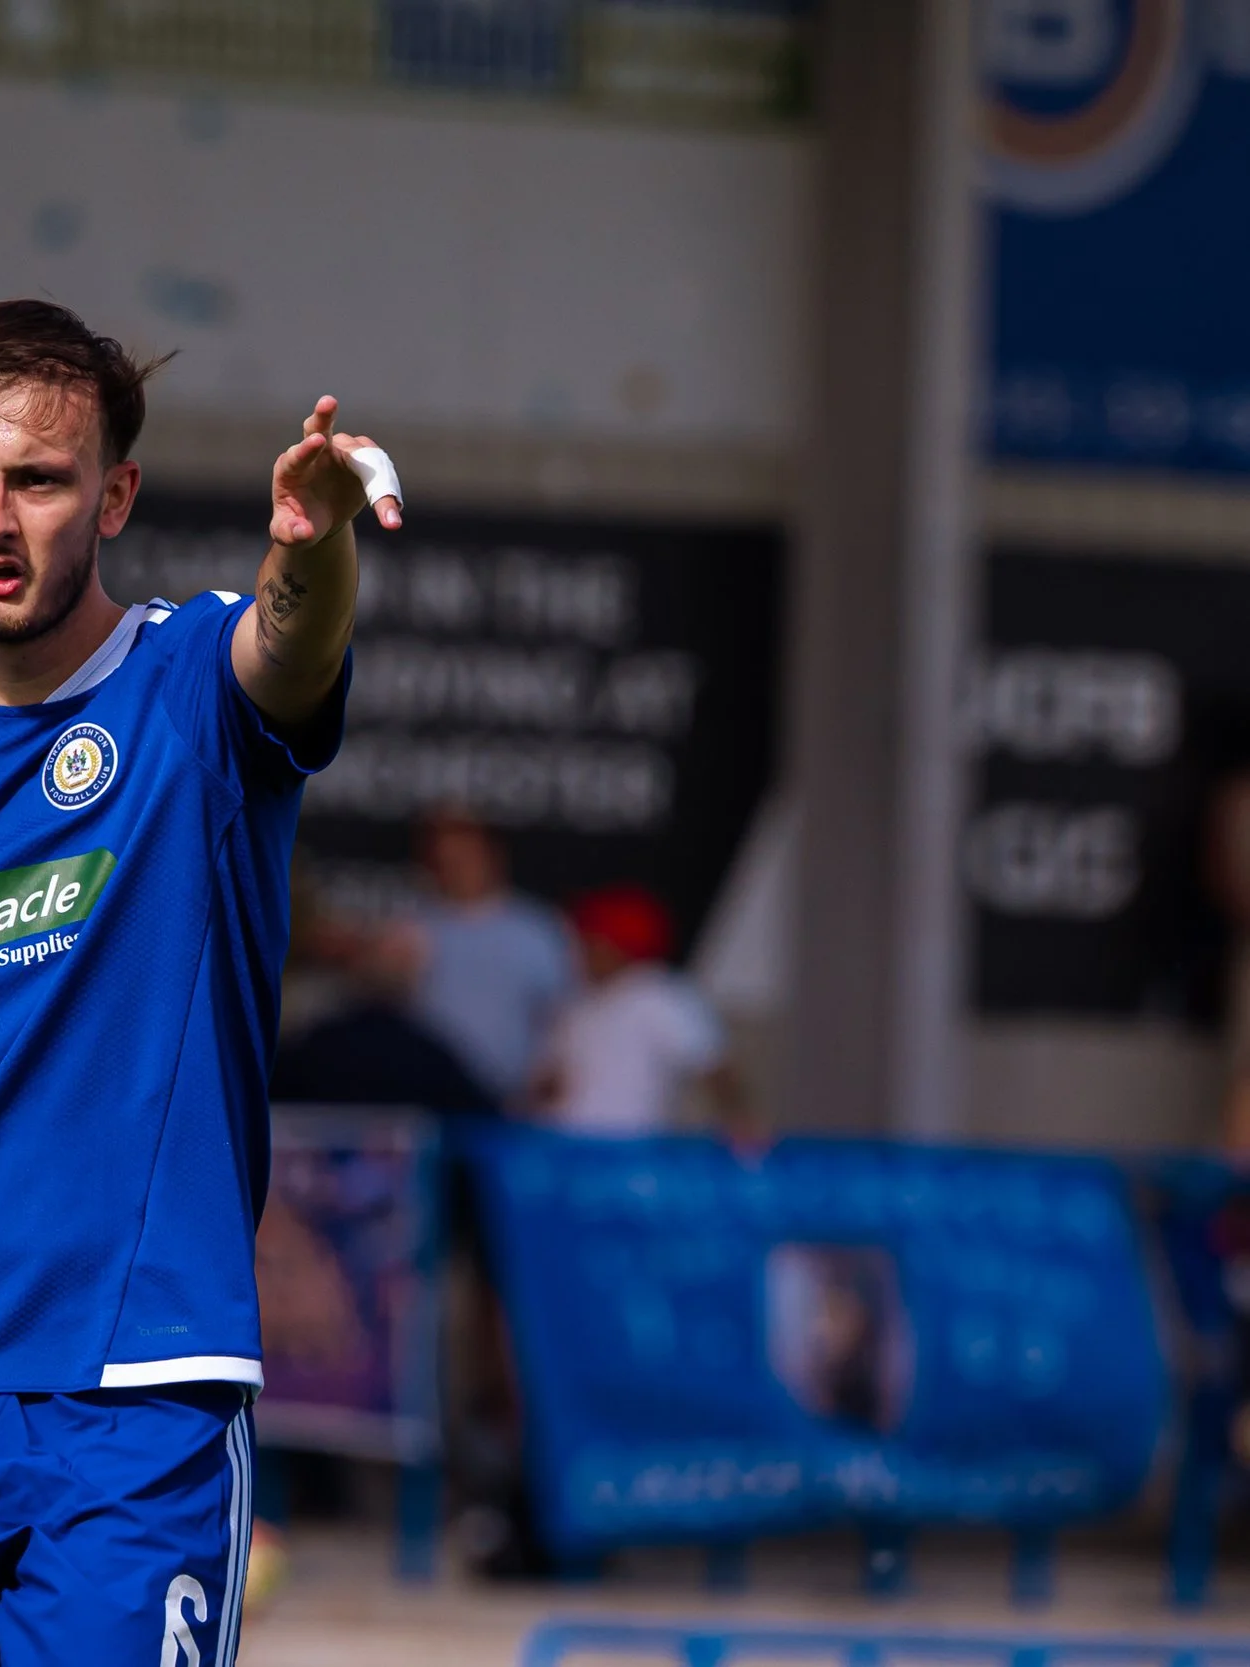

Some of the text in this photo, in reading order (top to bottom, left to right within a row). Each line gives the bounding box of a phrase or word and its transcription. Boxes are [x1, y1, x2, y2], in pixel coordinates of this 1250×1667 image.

[46, 727, 109, 771] CURZON ASHTON
[49, 765, 111, 804] FOOTBALL CLUB
